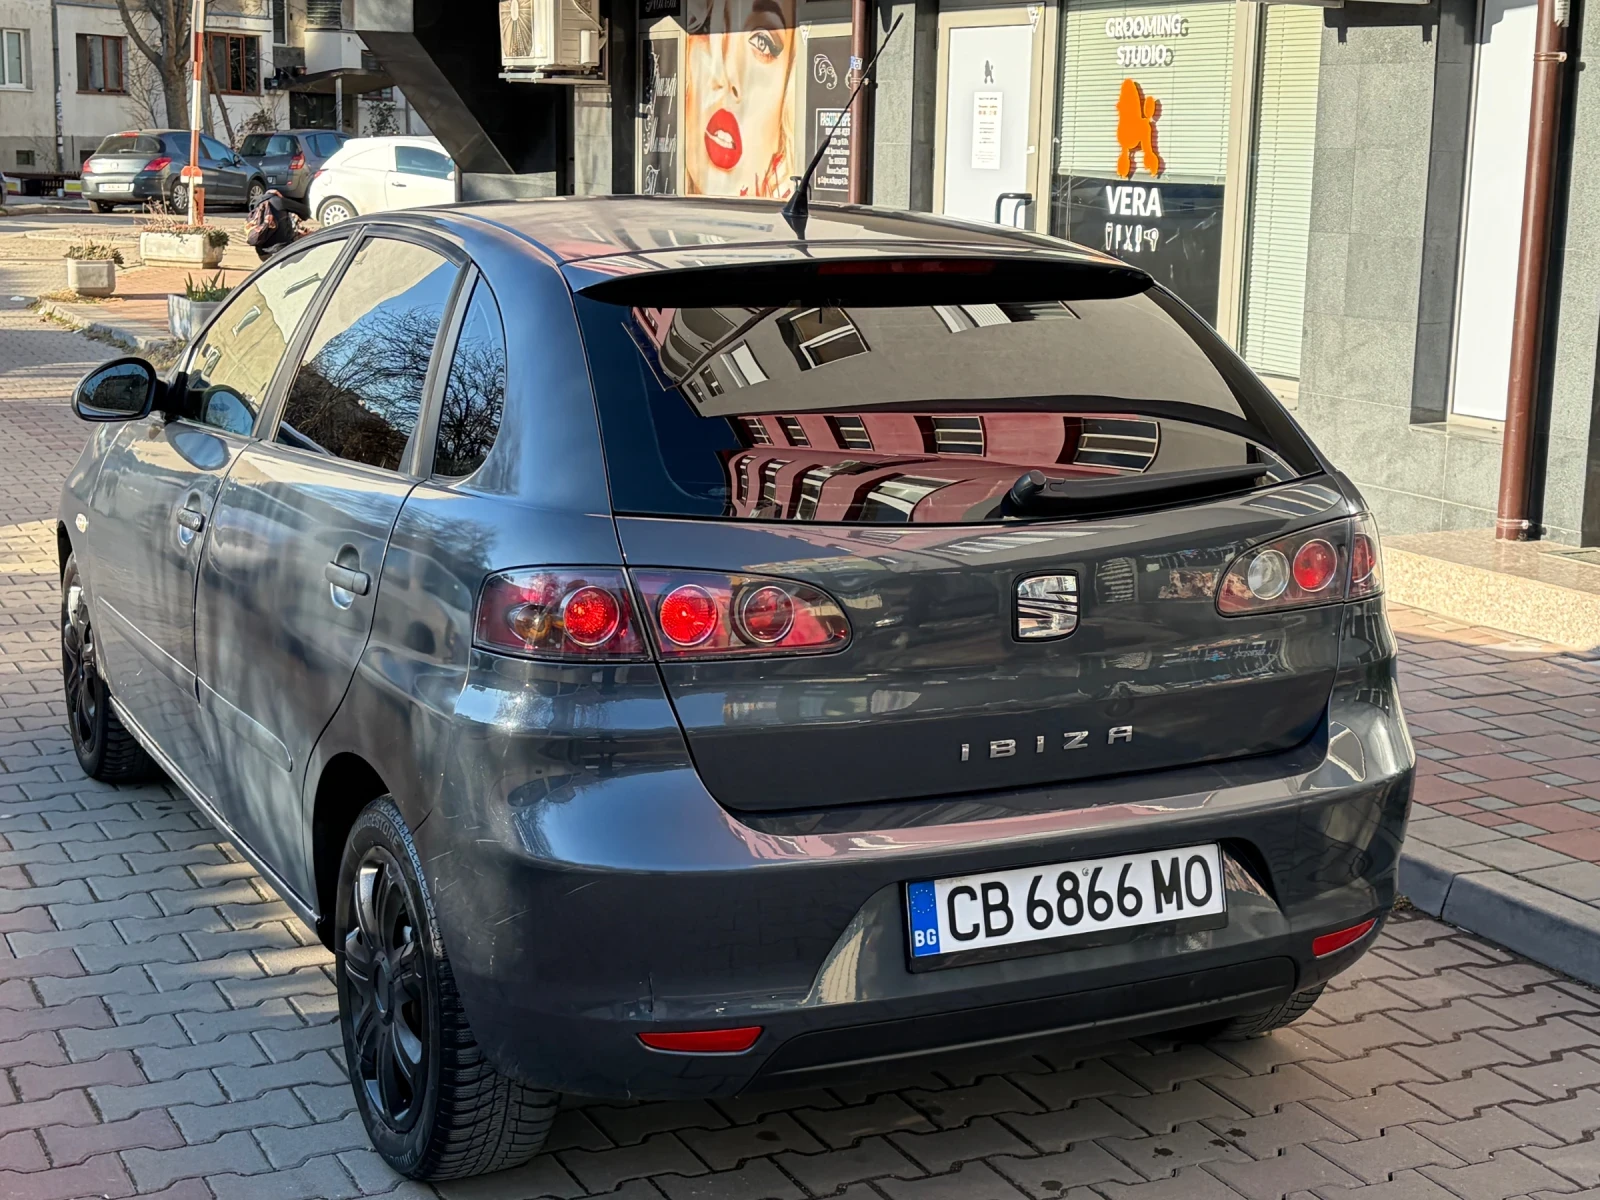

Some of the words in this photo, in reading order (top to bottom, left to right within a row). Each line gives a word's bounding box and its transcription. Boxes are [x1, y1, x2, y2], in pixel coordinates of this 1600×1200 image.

[1105, 14, 1181, 37] GROOMING
[1116, 44, 1167, 65] STUDIO
[1106, 185, 1162, 217] VERA
[961, 725, 1133, 761] IBIZA
[947, 881, 1014, 941] CB
[1026, 863, 1143, 930] 6866
[1151, 855, 1212, 914] MO
[914, 929, 937, 947] BG
